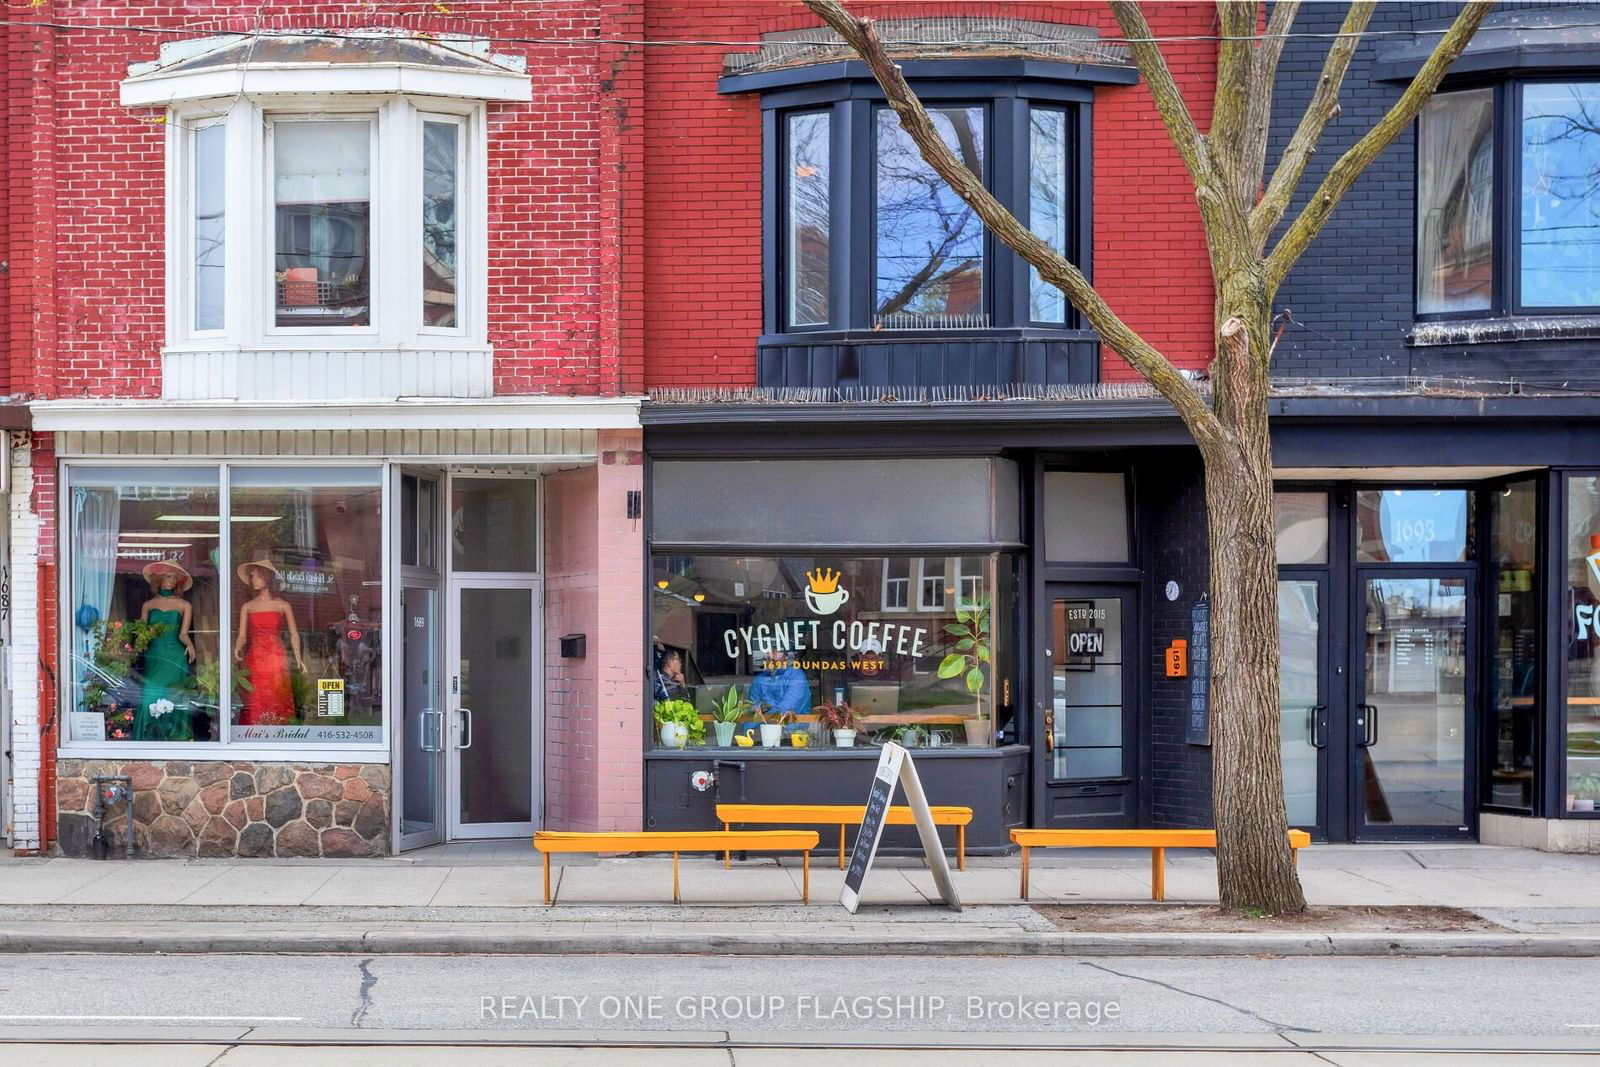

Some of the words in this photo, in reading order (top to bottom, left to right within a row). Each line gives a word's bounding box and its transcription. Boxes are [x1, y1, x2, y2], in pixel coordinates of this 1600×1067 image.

[1395, 519, 1435, 542] 1693
[1, 565, 9, 621] 1687
[1089, 608, 1106, 620] 2015
[723, 620, 821, 659] CYGNET
[832, 619, 927, 658] COFFEE
[1070, 632, 1103, 653] OPEN
[763, 660, 788, 670] 1691
[793, 660, 846, 670] DUNDAS
[851, 660, 885, 670] WEST
[1173, 650, 1181, 675] 1691
[322, 681, 340, 690] OPEN
[238, 728, 270, 739] Mai's
[272, 728, 311, 739] Bridal
[316, 731, 374, 739] 416-532-4508
